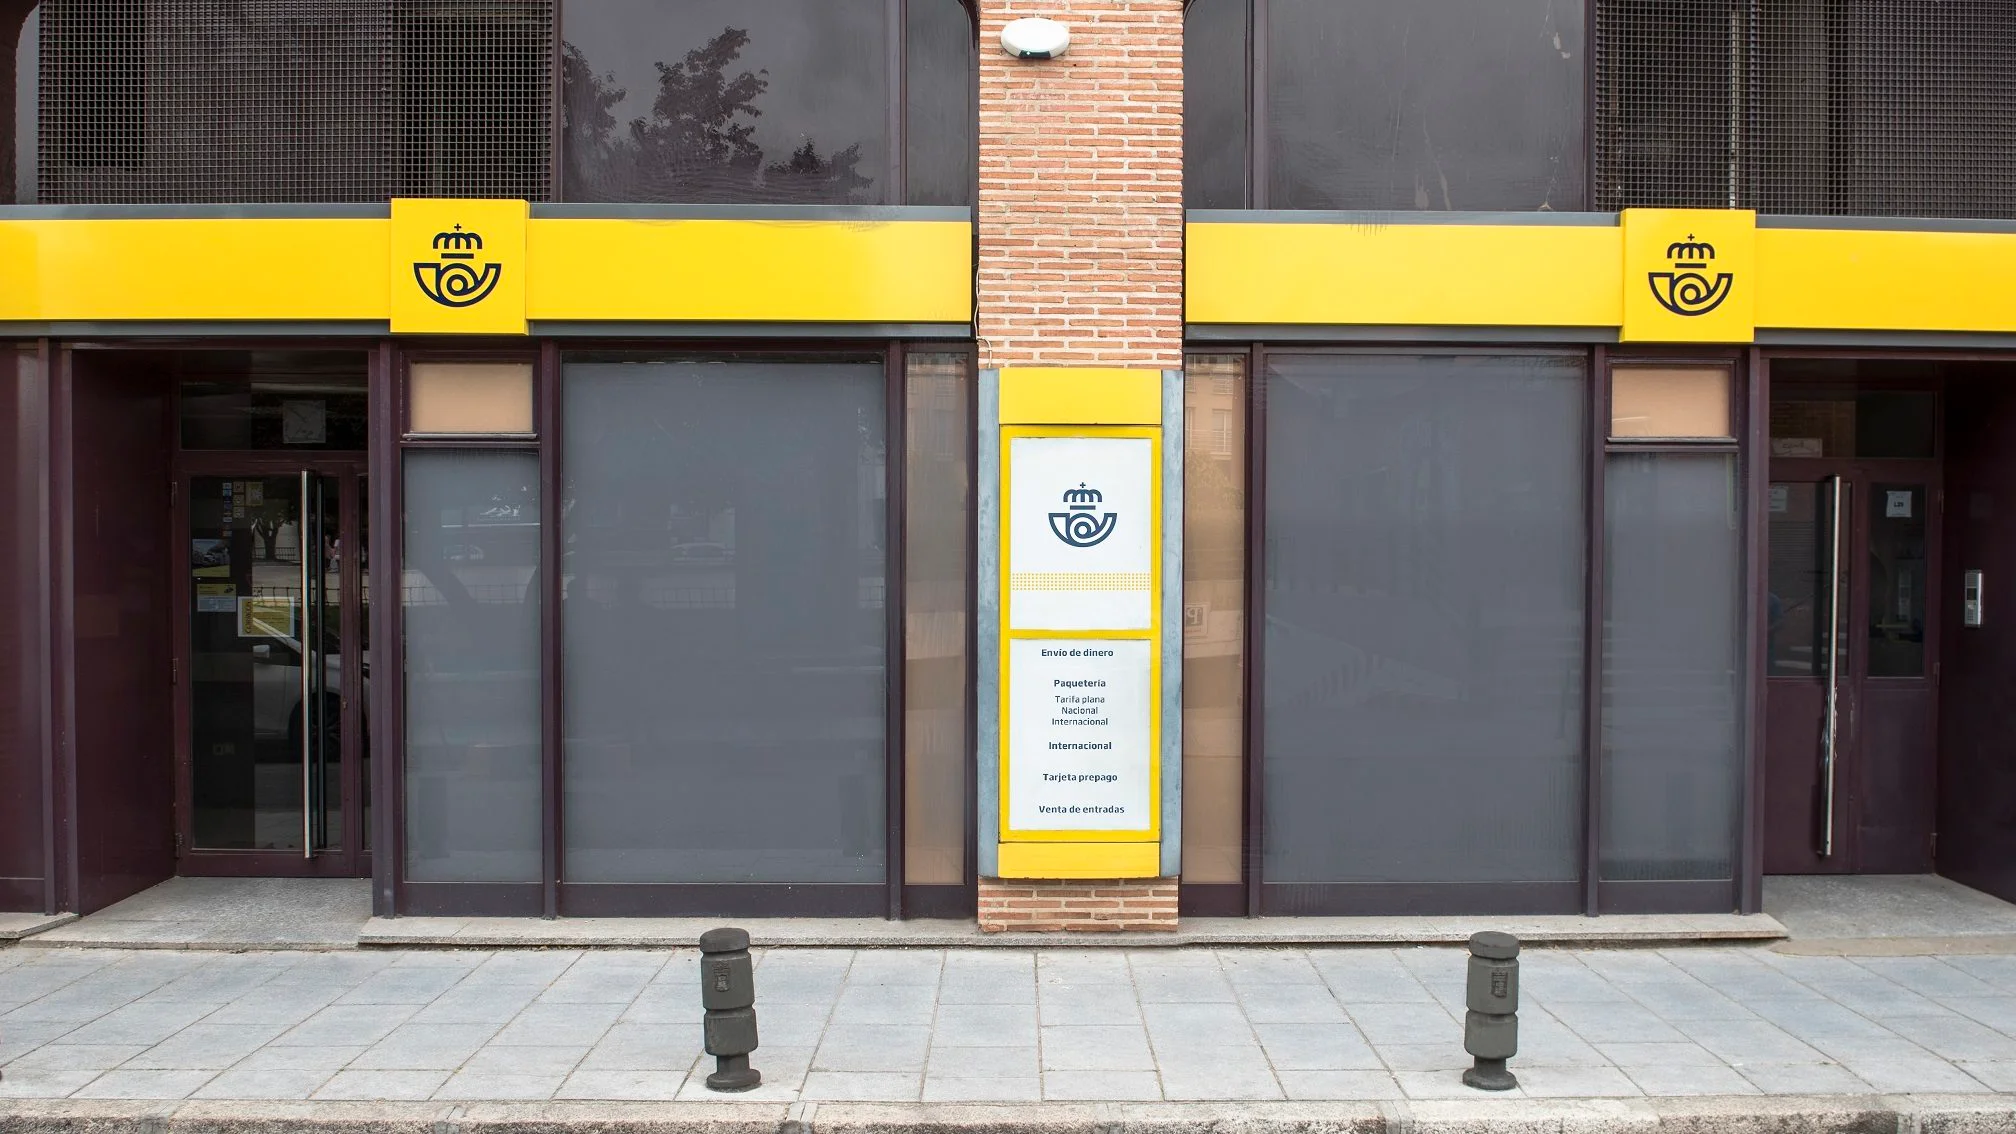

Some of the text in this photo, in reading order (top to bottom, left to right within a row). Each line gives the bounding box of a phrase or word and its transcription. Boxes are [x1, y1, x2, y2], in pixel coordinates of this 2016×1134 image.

[1069, 648, 1082, 657] de
[1083, 648, 1114, 657] dinero
[1053, 678, 1106, 689] Paquetería
[1054, 695, 1105, 705] Tarifa plana
[1061, 706, 1099, 715] Nacional
[1051, 717, 1109, 726] Internacional
[1048, 741, 1112, 750] Internacional
[1042, 772, 1118, 783] Tarjeta prepago
[1038, 805, 1125, 814] Venta de entradas
